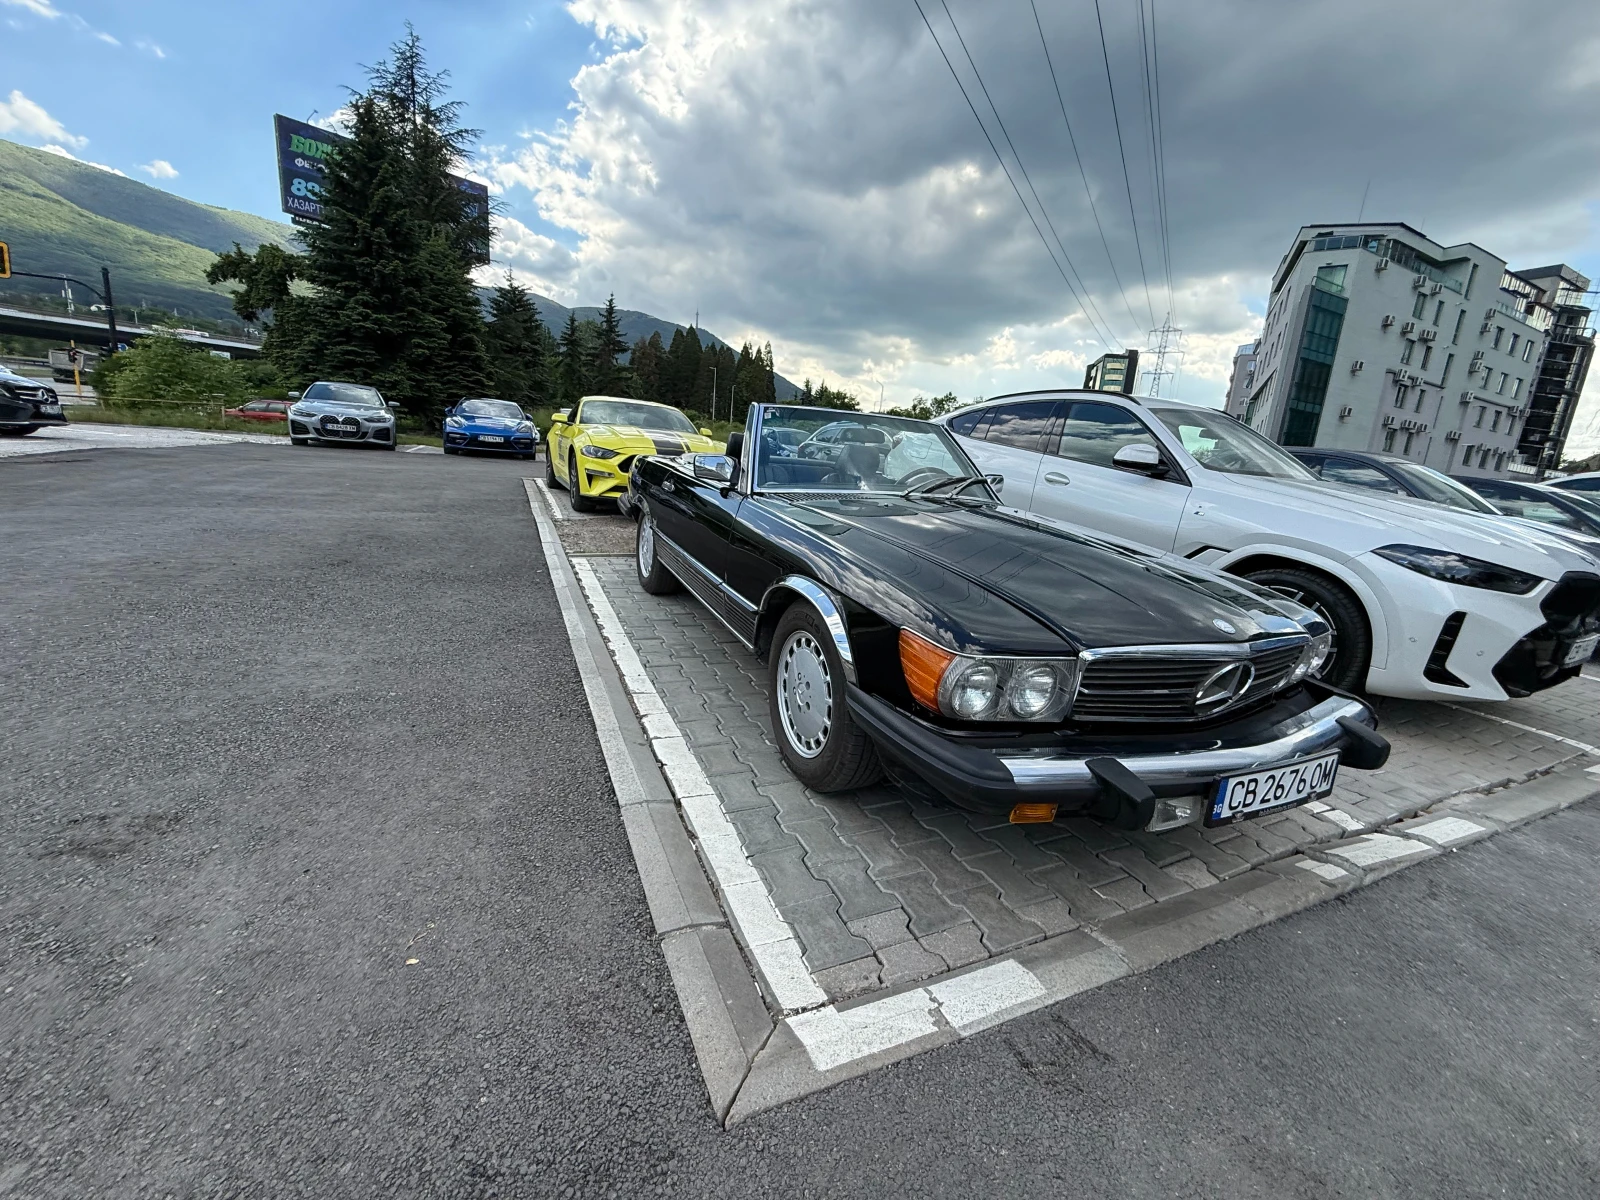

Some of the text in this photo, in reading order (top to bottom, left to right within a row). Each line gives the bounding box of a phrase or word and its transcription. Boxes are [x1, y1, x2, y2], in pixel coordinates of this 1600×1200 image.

[1228, 777, 1259, 811] CB
[1259, 765, 1309, 804] 2676
[1309, 758, 1335, 790] OM
